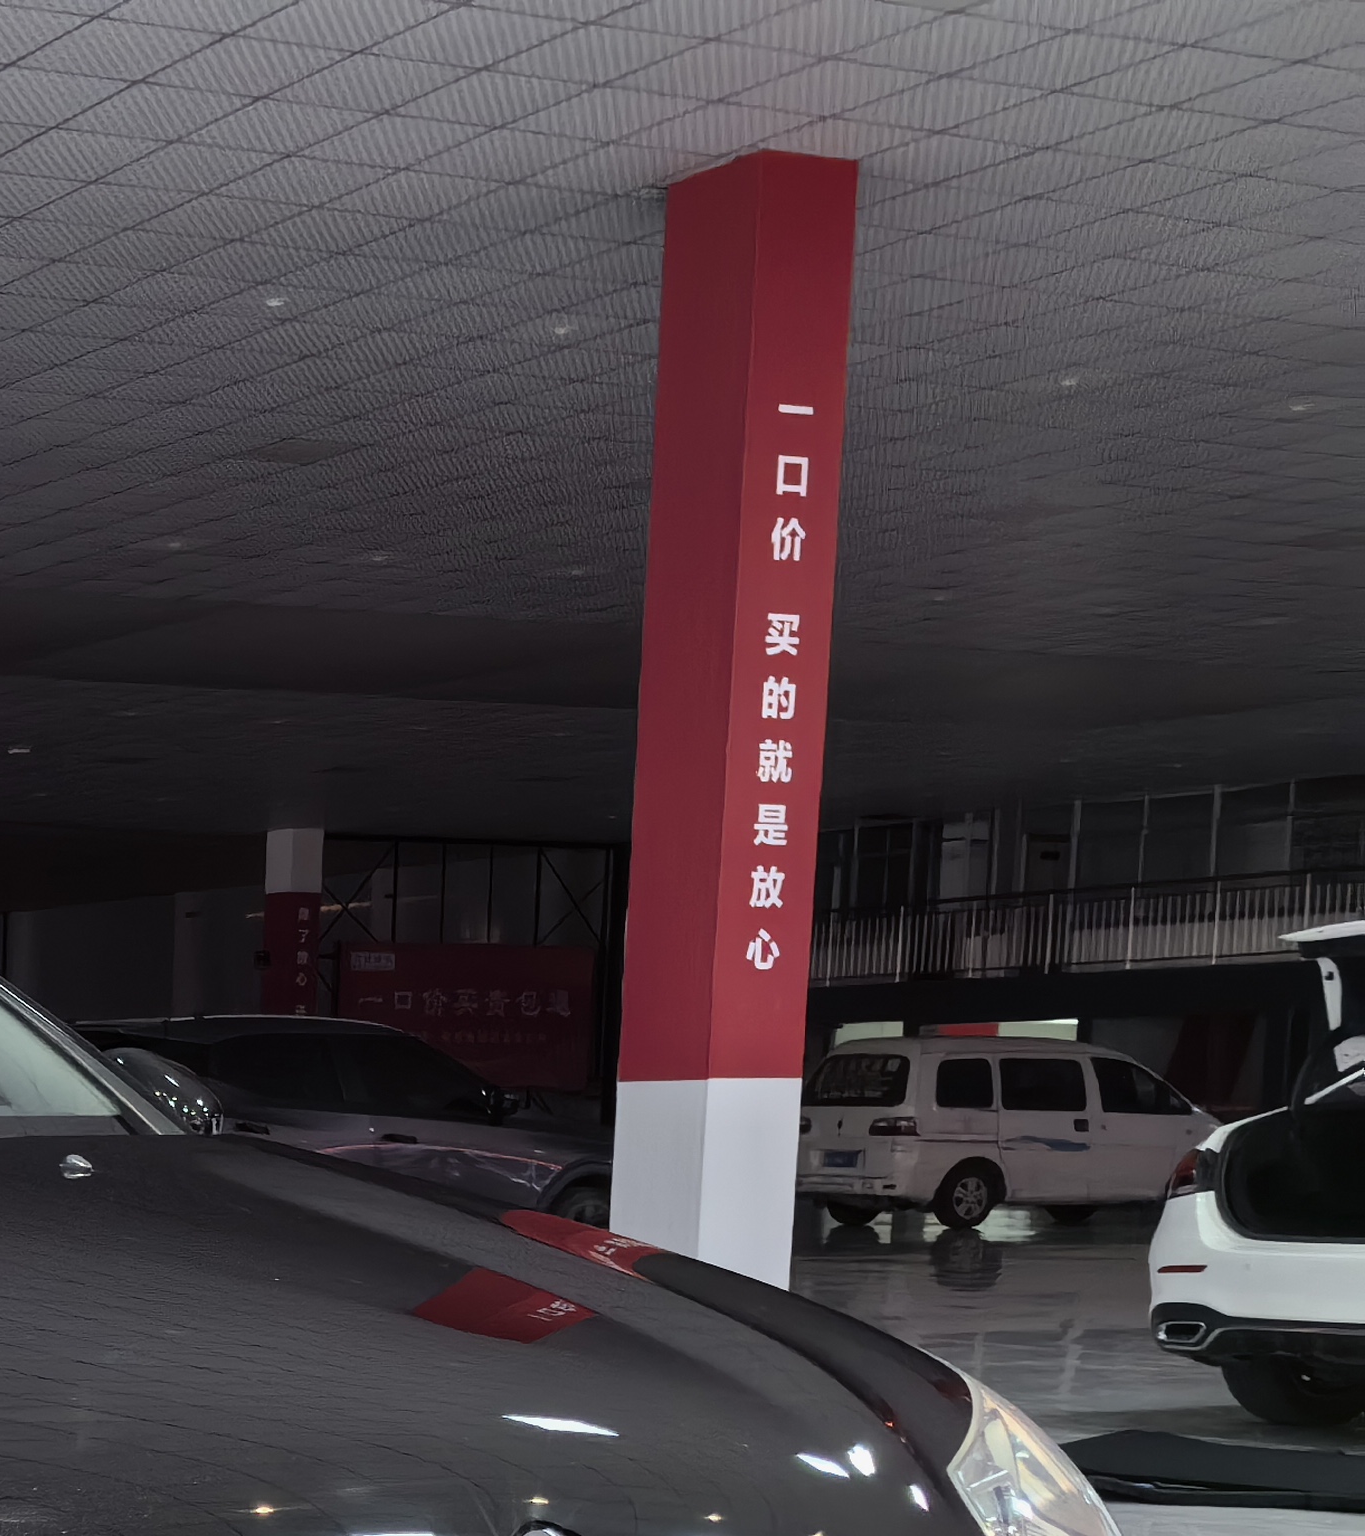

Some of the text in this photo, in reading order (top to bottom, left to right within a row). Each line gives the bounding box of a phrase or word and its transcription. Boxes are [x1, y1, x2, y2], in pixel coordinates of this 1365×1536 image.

[770, 403, 815, 562] 一口价
[746, 612, 802, 971] 买的就是放心
